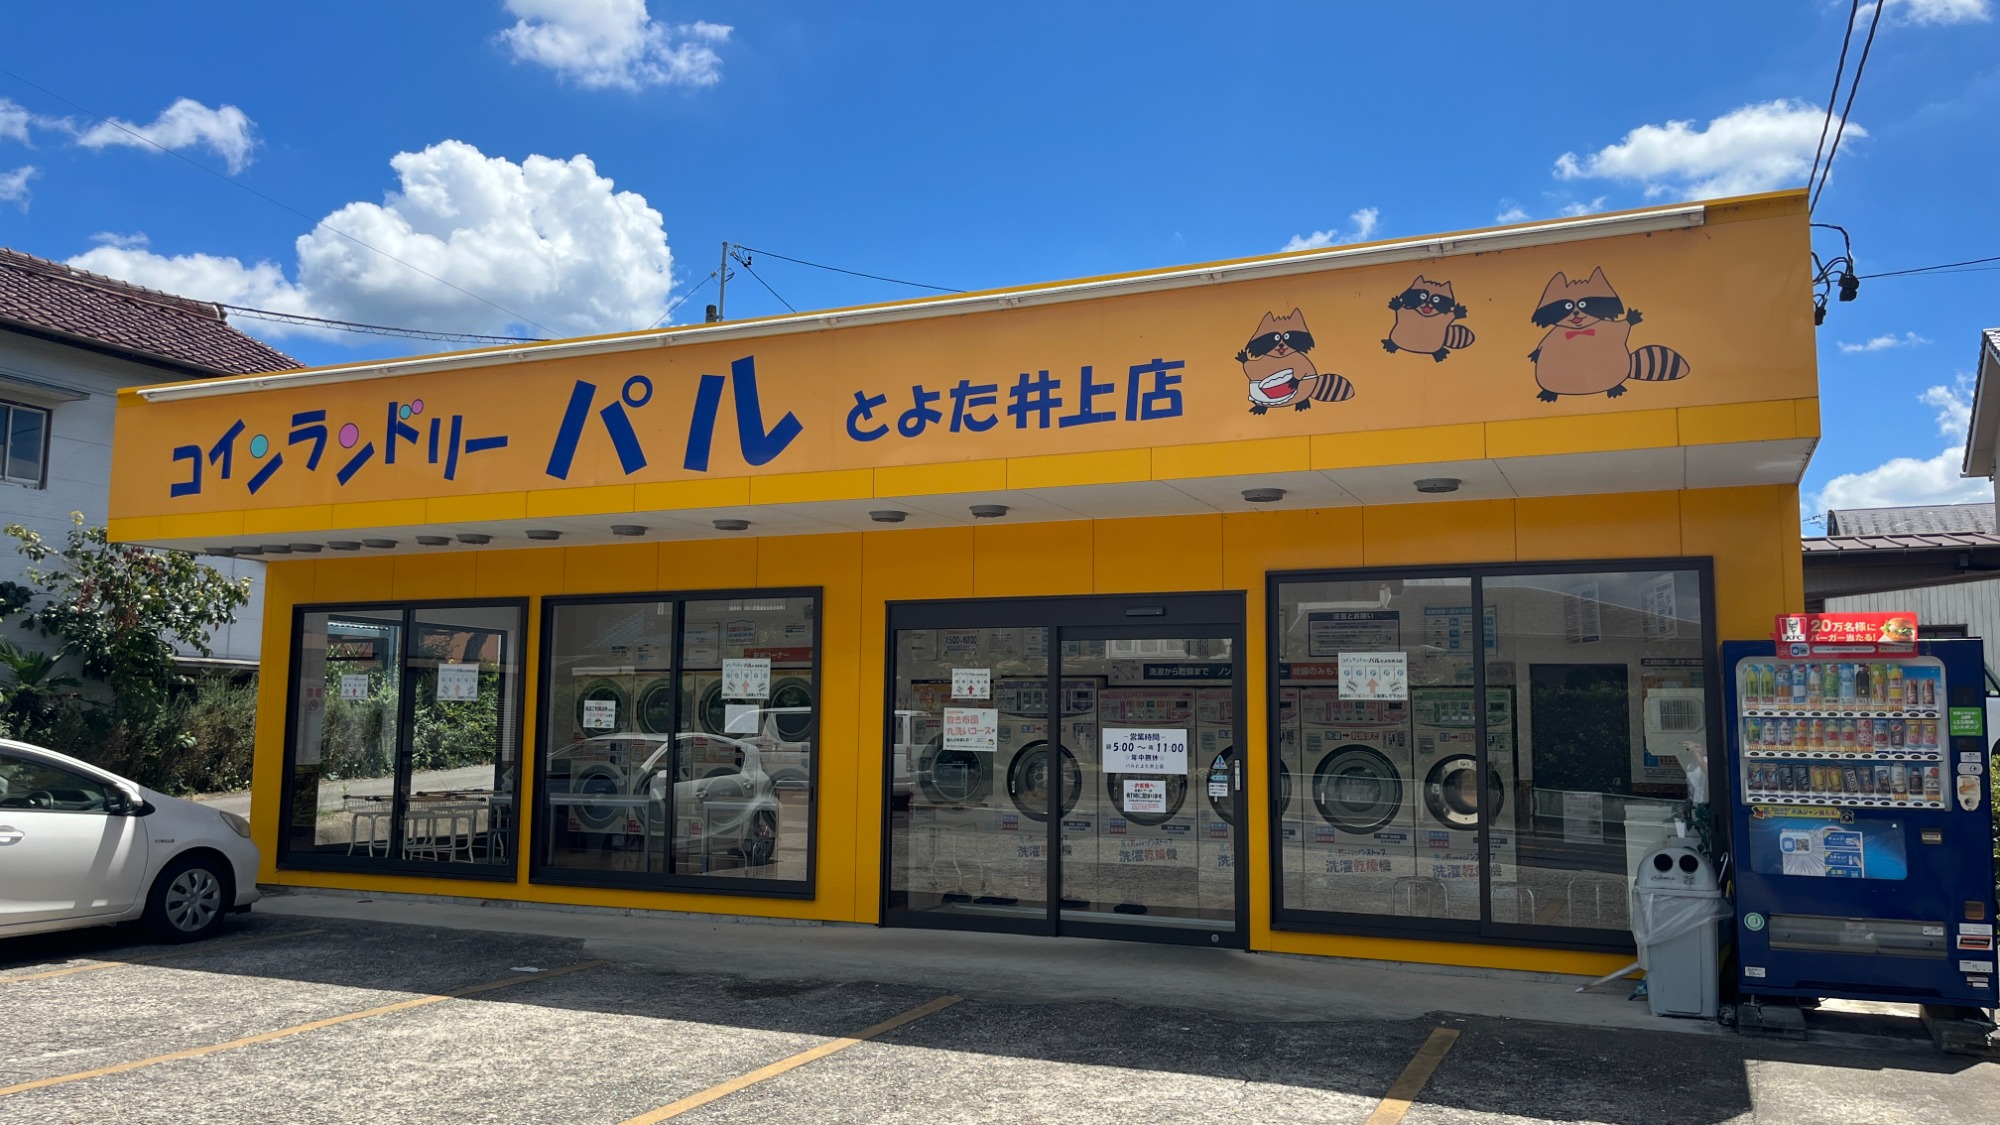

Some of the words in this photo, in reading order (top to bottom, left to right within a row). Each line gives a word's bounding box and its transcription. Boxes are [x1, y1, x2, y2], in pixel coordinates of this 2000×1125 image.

[170, 398, 508, 497] コインランドリー
[546, 355, 803, 480] パル
[846, 358, 1186, 441] とよた井上店
[1810, 619, 1877, 633] 20万名様に
[1810, 633, 1877, 642] バーガー当たる!
[1149, 667, 1209, 676] 洗濯から乾燥まで
[946, 715, 979, 724] 敷き布団
[1129, 733, 1161, 741] 営業時間
[1113, 742, 1135, 752] 5:00
[1156, 743, 1184, 753] 11:00
[1131, 754, 1159, 762] 年中無休
[1119, 848, 1178, 863] 洗濯乾燥機
[1326, 859, 1392, 873] 洗濯乾燥機
